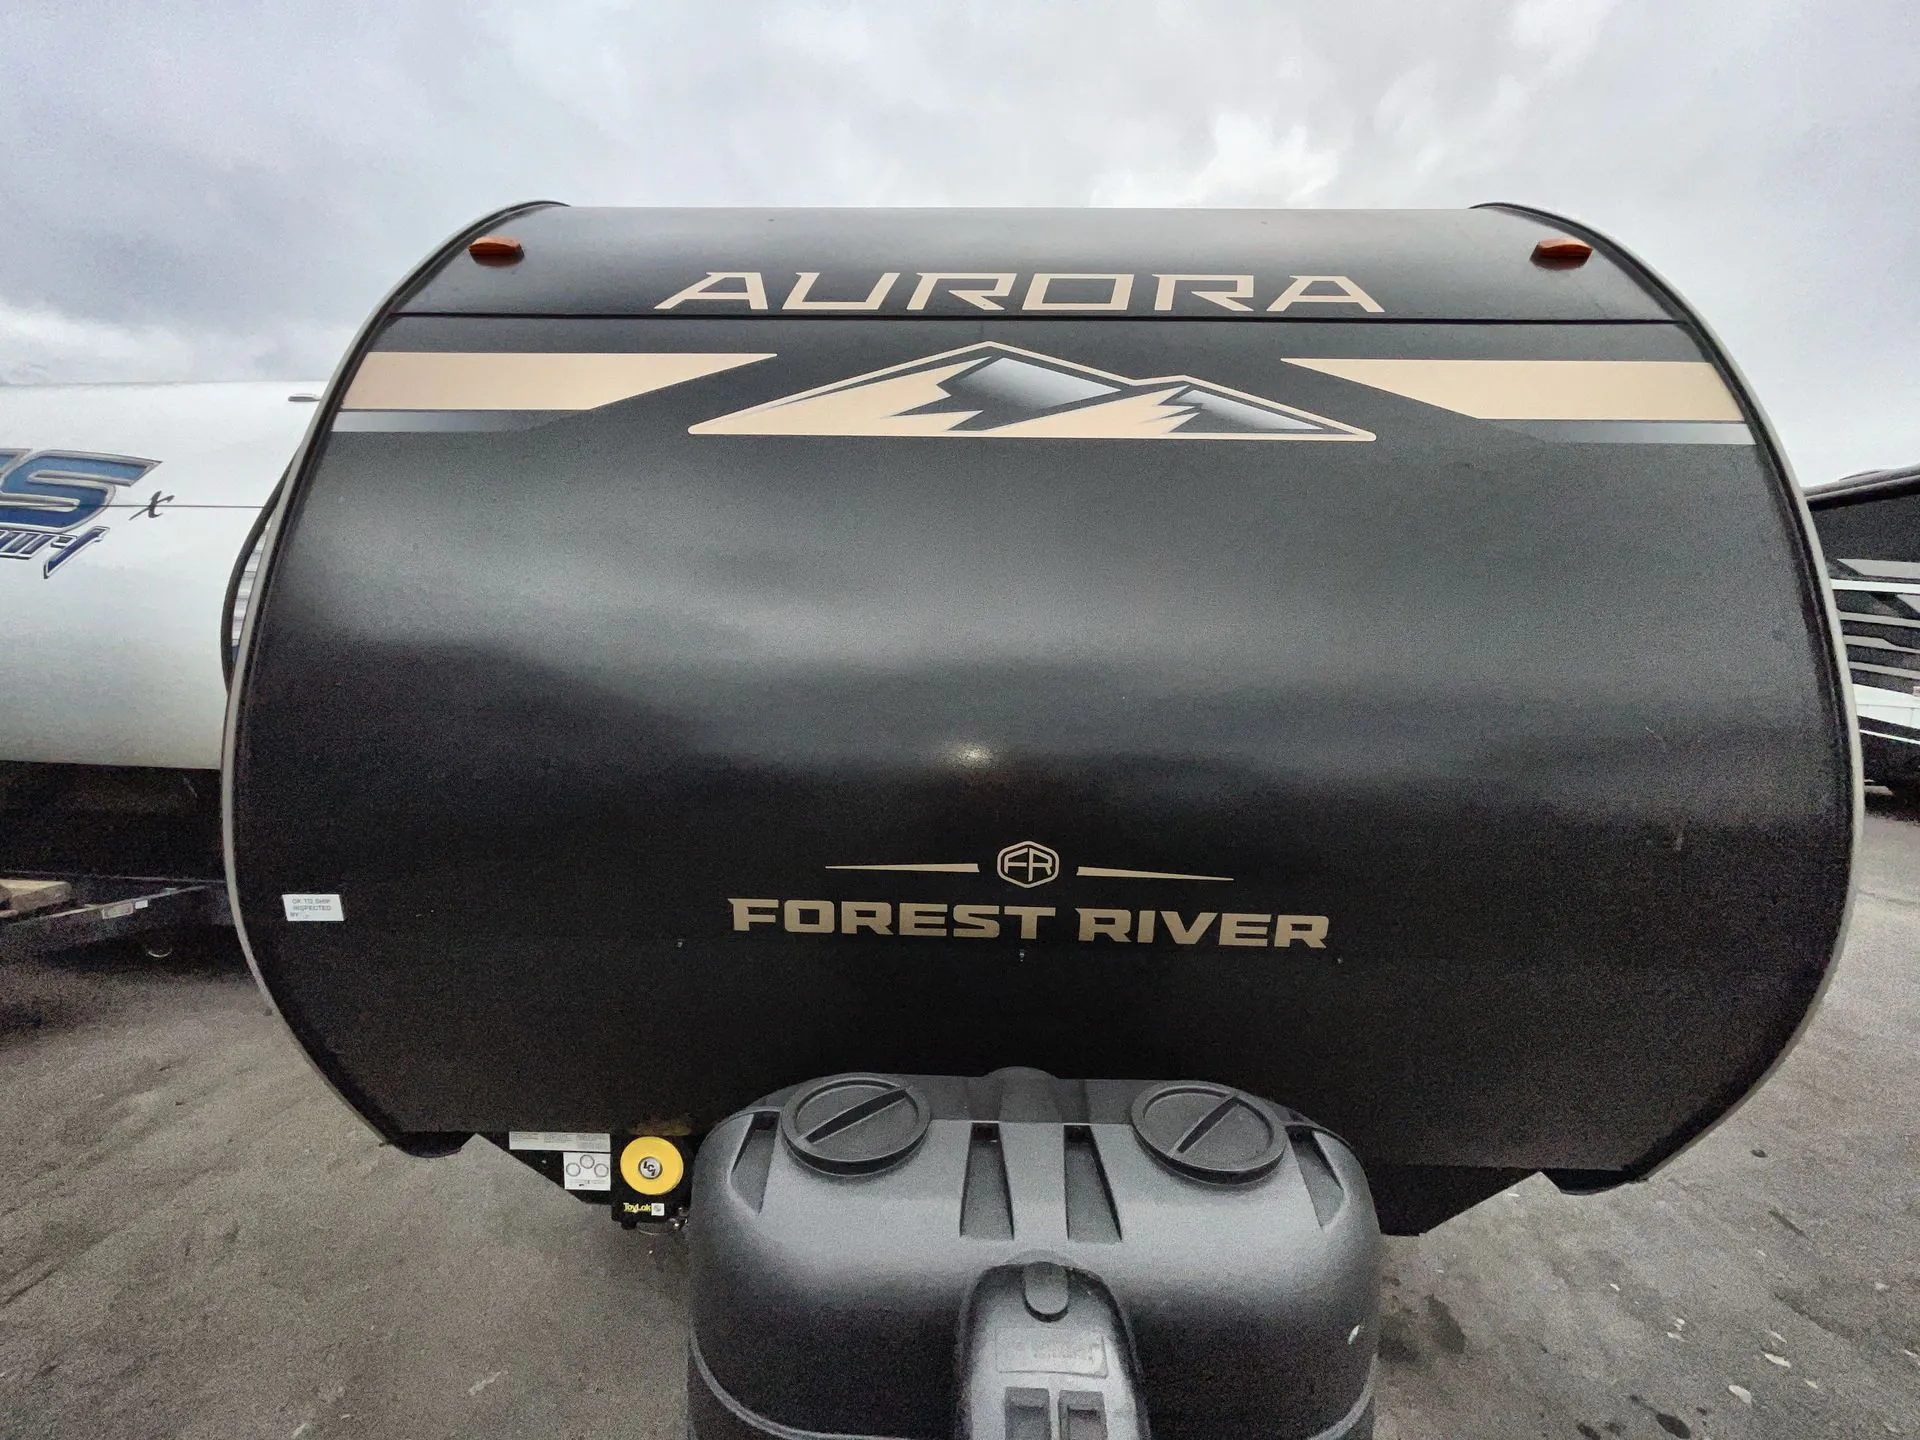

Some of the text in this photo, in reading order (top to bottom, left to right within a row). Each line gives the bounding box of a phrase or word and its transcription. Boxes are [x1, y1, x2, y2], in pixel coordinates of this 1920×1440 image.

[652, 271, 1386, 313] AURORA
[727, 898, 1330, 949] FOREST RIVER
